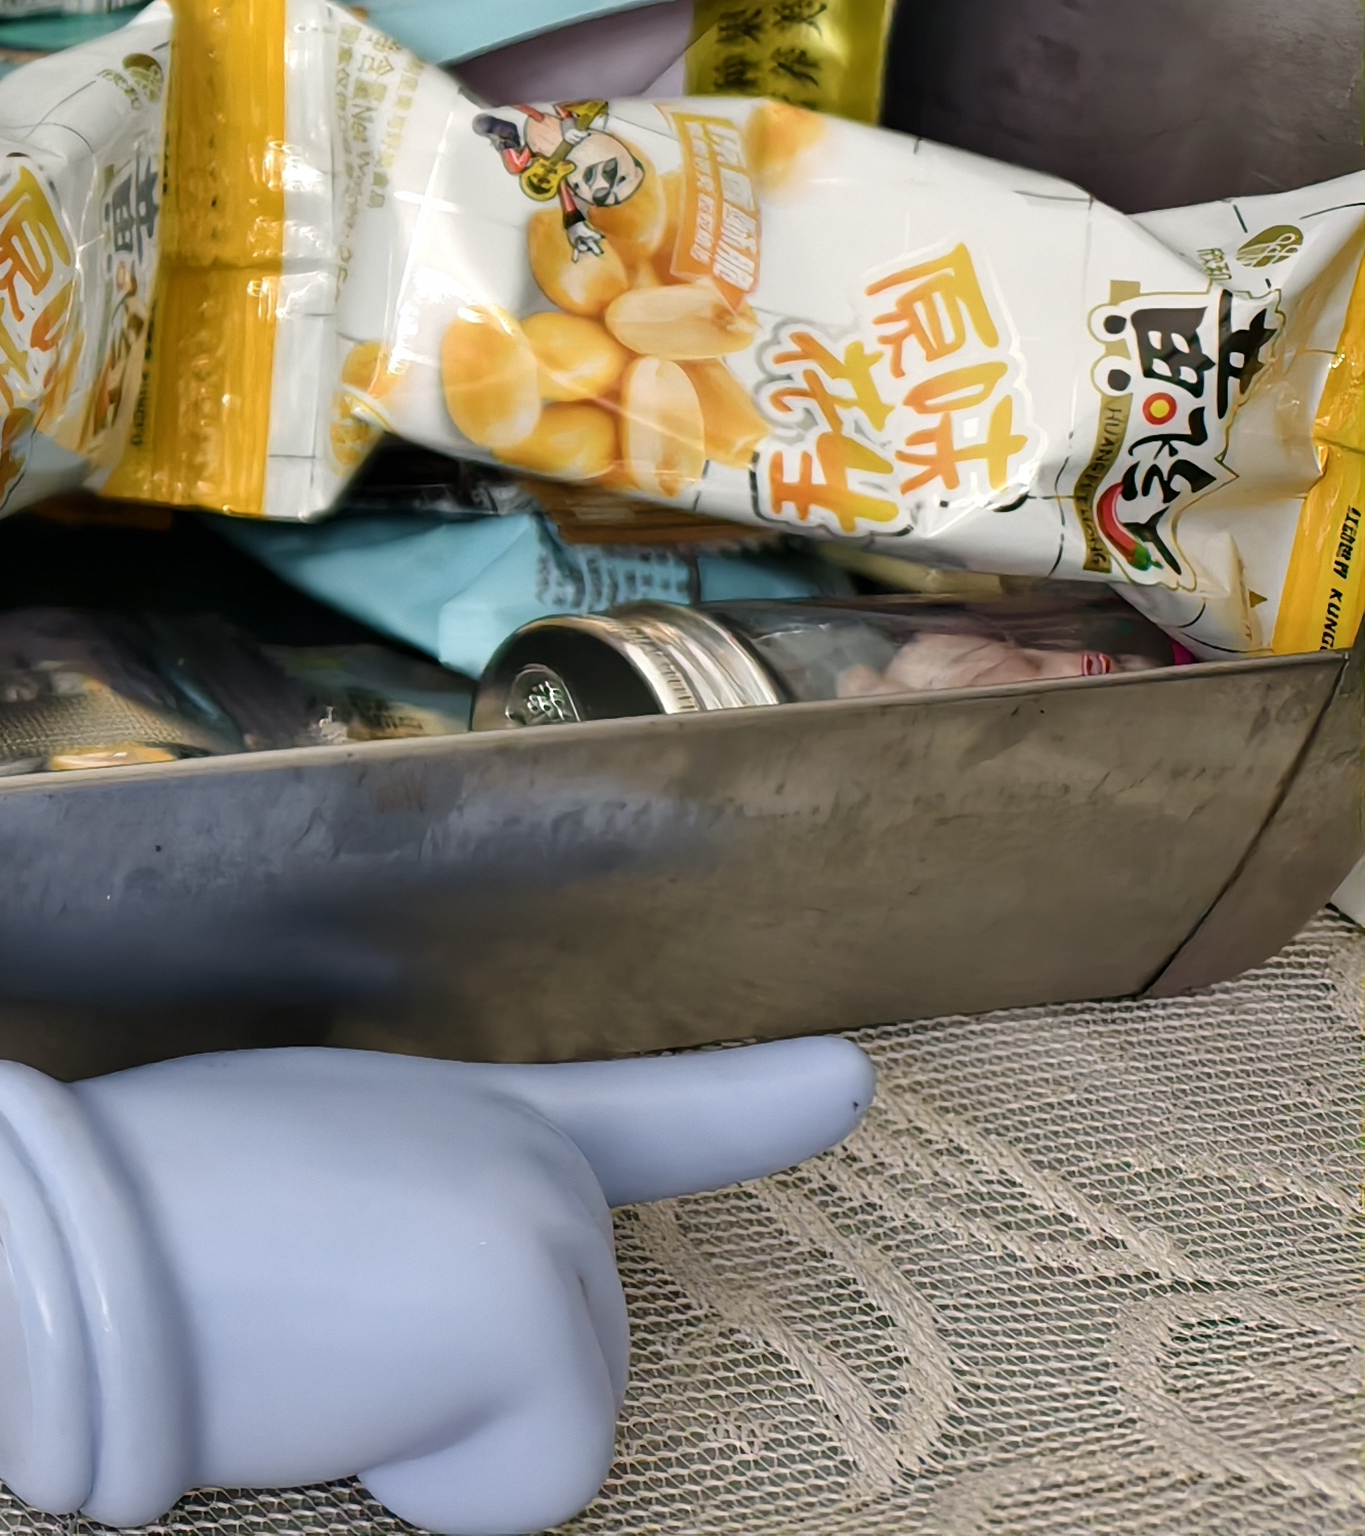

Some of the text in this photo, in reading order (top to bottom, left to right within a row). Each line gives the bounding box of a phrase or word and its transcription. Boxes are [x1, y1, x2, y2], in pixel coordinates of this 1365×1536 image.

[768, 330, 901, 534] 花生
[863, 242, 1029, 496] 原味
[1104, 290, 1277, 576] 黄飞红
